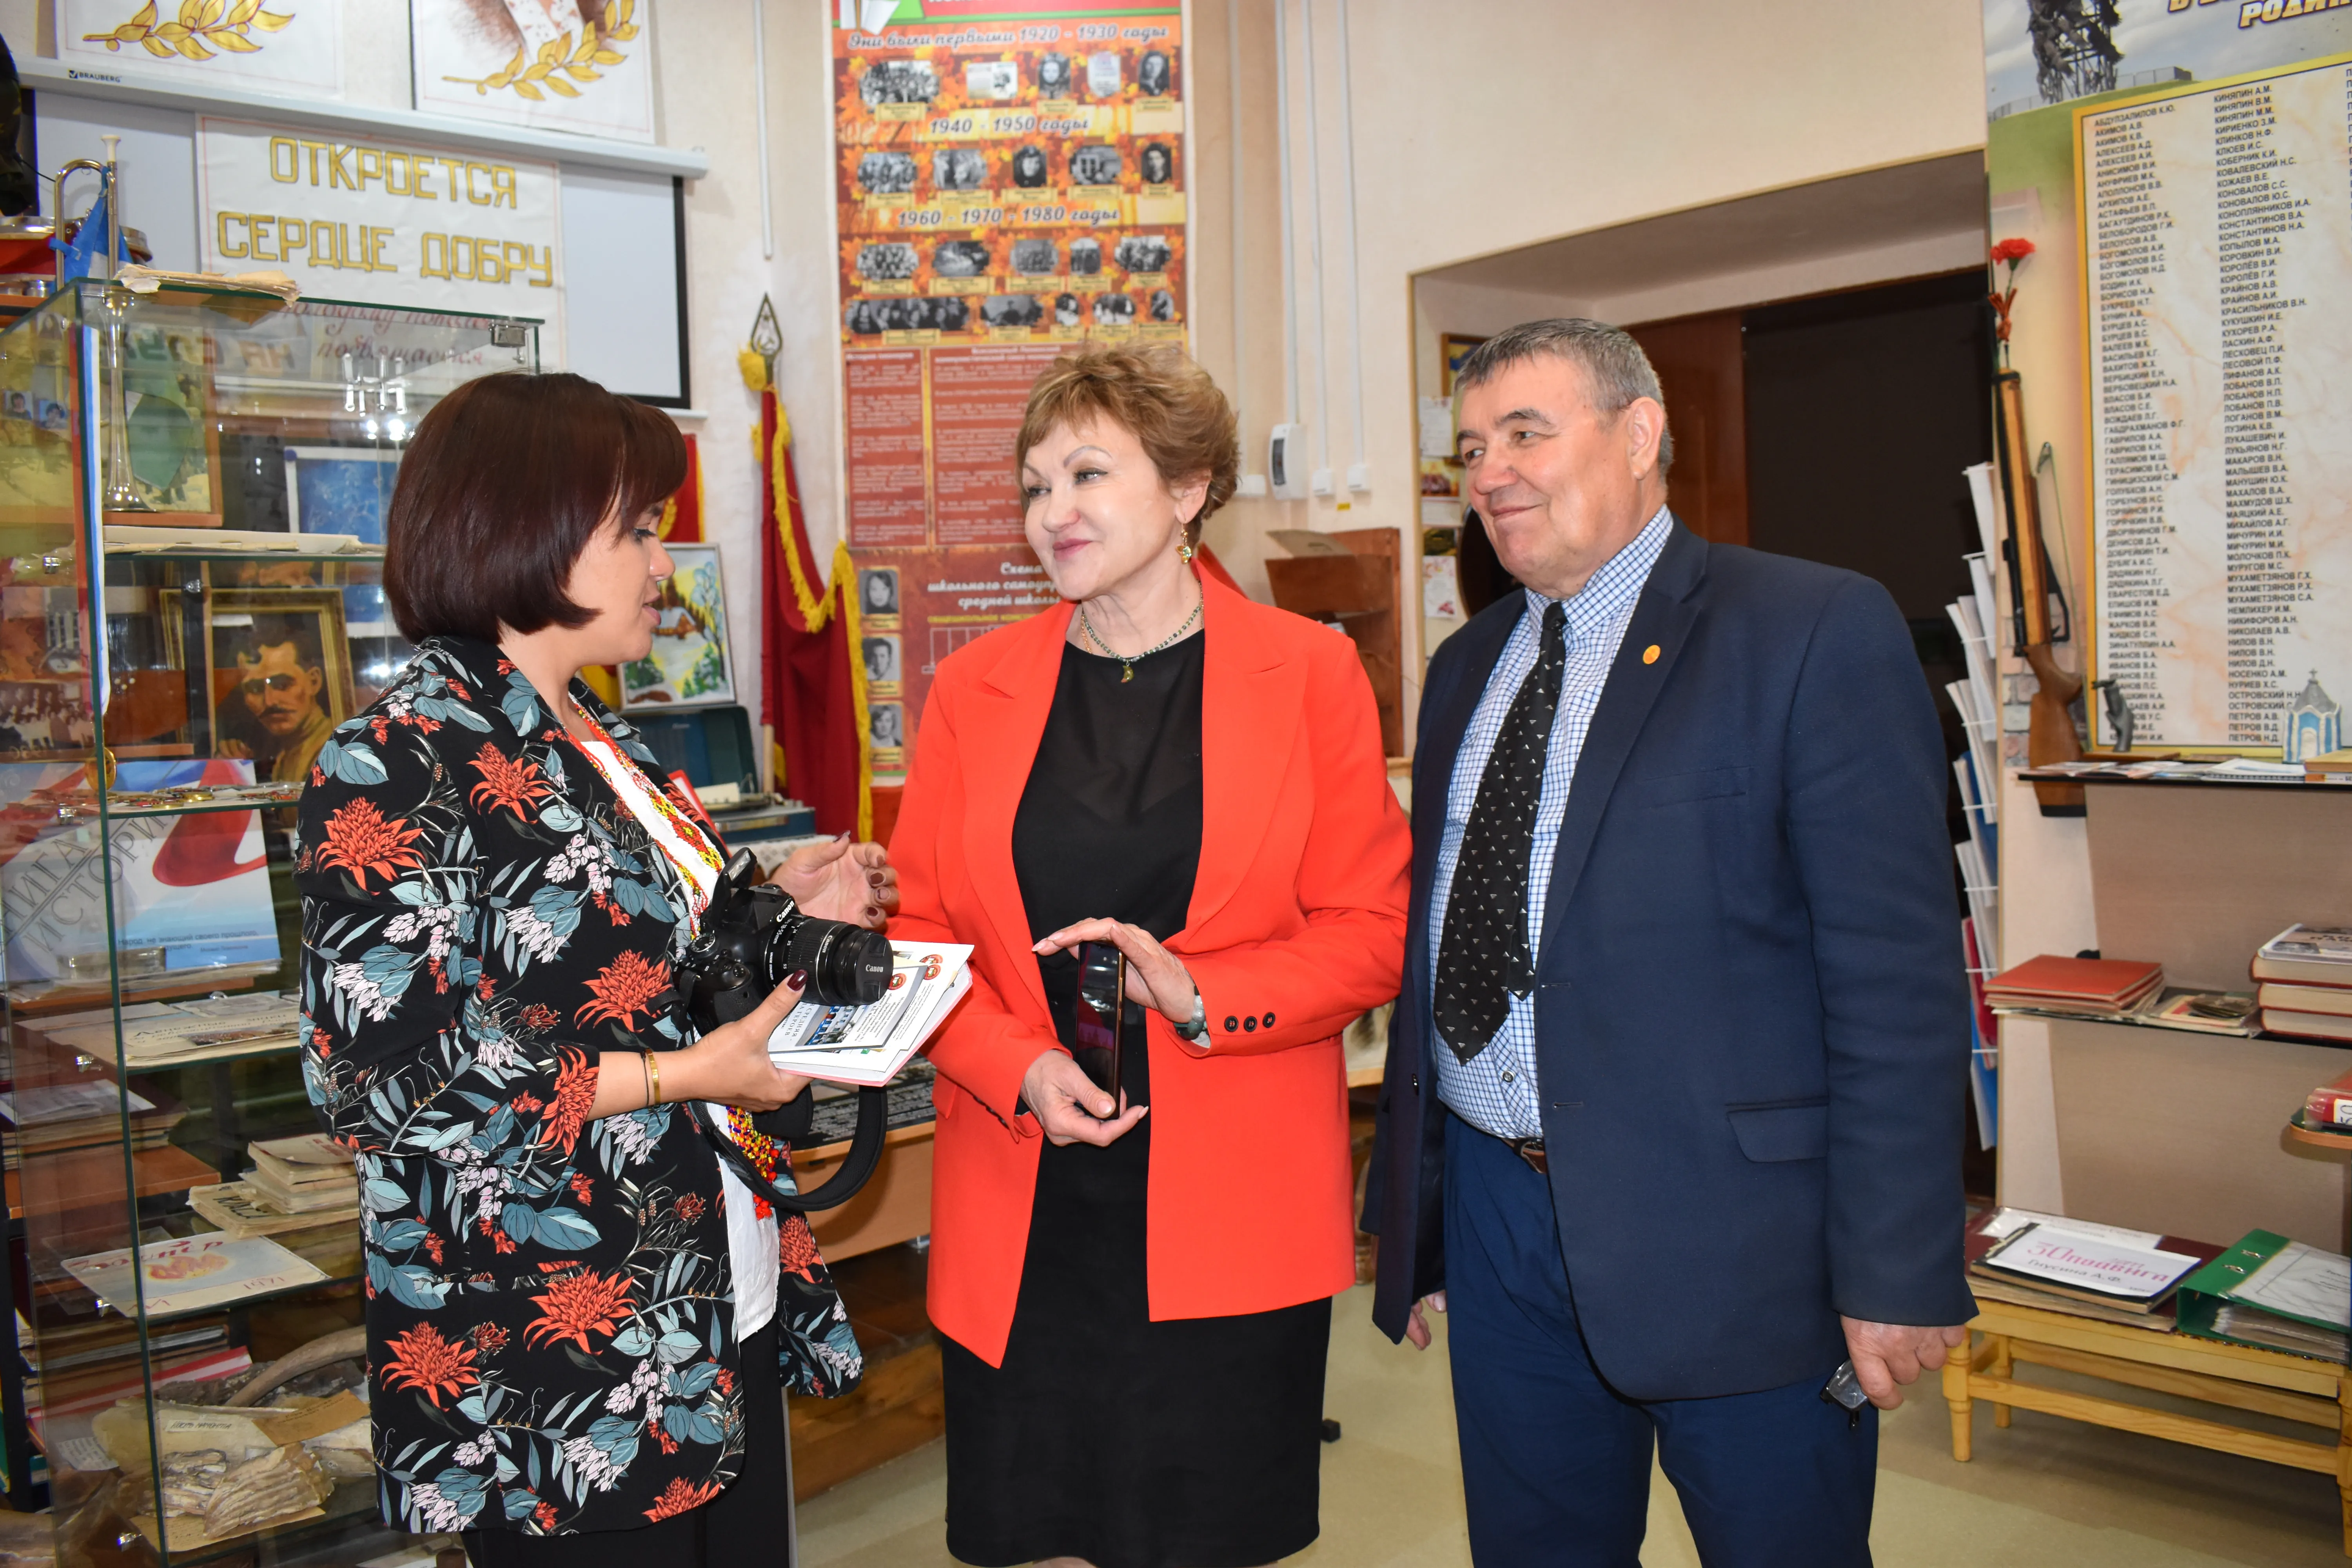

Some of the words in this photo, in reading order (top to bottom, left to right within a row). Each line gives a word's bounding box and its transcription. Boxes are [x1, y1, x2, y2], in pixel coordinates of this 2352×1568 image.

[1019, 25, 1058, 43] 1920
[1078, 24, 1118, 41] 1930
[1122, 26, 1169, 44] годы
[79, 72, 122, 83] BRAUBERG
[2214, 89, 2252, 102] КИНЯПИН
[2214, 100, 2253, 113] КИНЯПИН
[2215, 111, 2253, 123] КИНЯПИН
[929, 118, 972, 134] 1940
[993, 116, 1037, 132] 1950
[1039, 119, 1089, 138] годы
[2215, 120, 2258, 134] КИРИЕНКО
[2216, 132, 2253, 145] КЛИНКОВ
[2216, 144, 2245, 155] КЛЮЕВ
[2216, 153, 2259, 166] КОБЕРНИК
[270, 136, 517, 209] ОТКРОЕТСЯ
[2217, 159, 2278, 176] КОВАЛЕВСКИЙ
[2217, 176, 2251, 187] КОЖАЕВ
[2218, 183, 2269, 198] КОНОВАЛОВ
[2218, 194, 2269, 209] КОНОВАЛОВ
[898, 211, 941, 227] 1960
[962, 208, 1003, 224] 1970
[1022, 206, 1065, 222] 1980
[1069, 209, 1120, 229] годы
[2218, 202, 2292, 219] КОНОПЛЯННИКОВ
[2219, 214, 2285, 230] КОНСТАНТИНОВ
[2219, 225, 2285, 241] КОНСТАНТИНОВ
[218, 211, 398, 273] СЕРДЦЕ
[420, 232, 553, 288] ДОБРУ
[2220, 240, 2261, 252] КОПЫЛОВ
[2220, 250, 2263, 262] КОРОВКИН
[2220, 260, 2258, 272] КОРОЛЁВ
[2220, 271, 2258, 283] КОРОЛЁВ
[2221, 282, 2259, 294] КРАЙНОВ
[1001, 562, 1043, 575] Схема
[927, 579, 1000, 592] школьного
[958, 595, 1012, 611] средней
[0, 838, 89, 934] НИГА
[24, 816, 174, 953] ИСТОРИ
[777, 900, 795, 922] Canon
[773, 924, 787, 944] 18-55mm
[822, 935, 833, 953] Canon
[866, 964, 884, 973] Canon
[784, 1011, 801, 1036] ГЕРОЕВ
[791, 1007, 812, 1038] СРЕДНЯЯ
[2028, 1259, 2087, 1276] Гнусина
